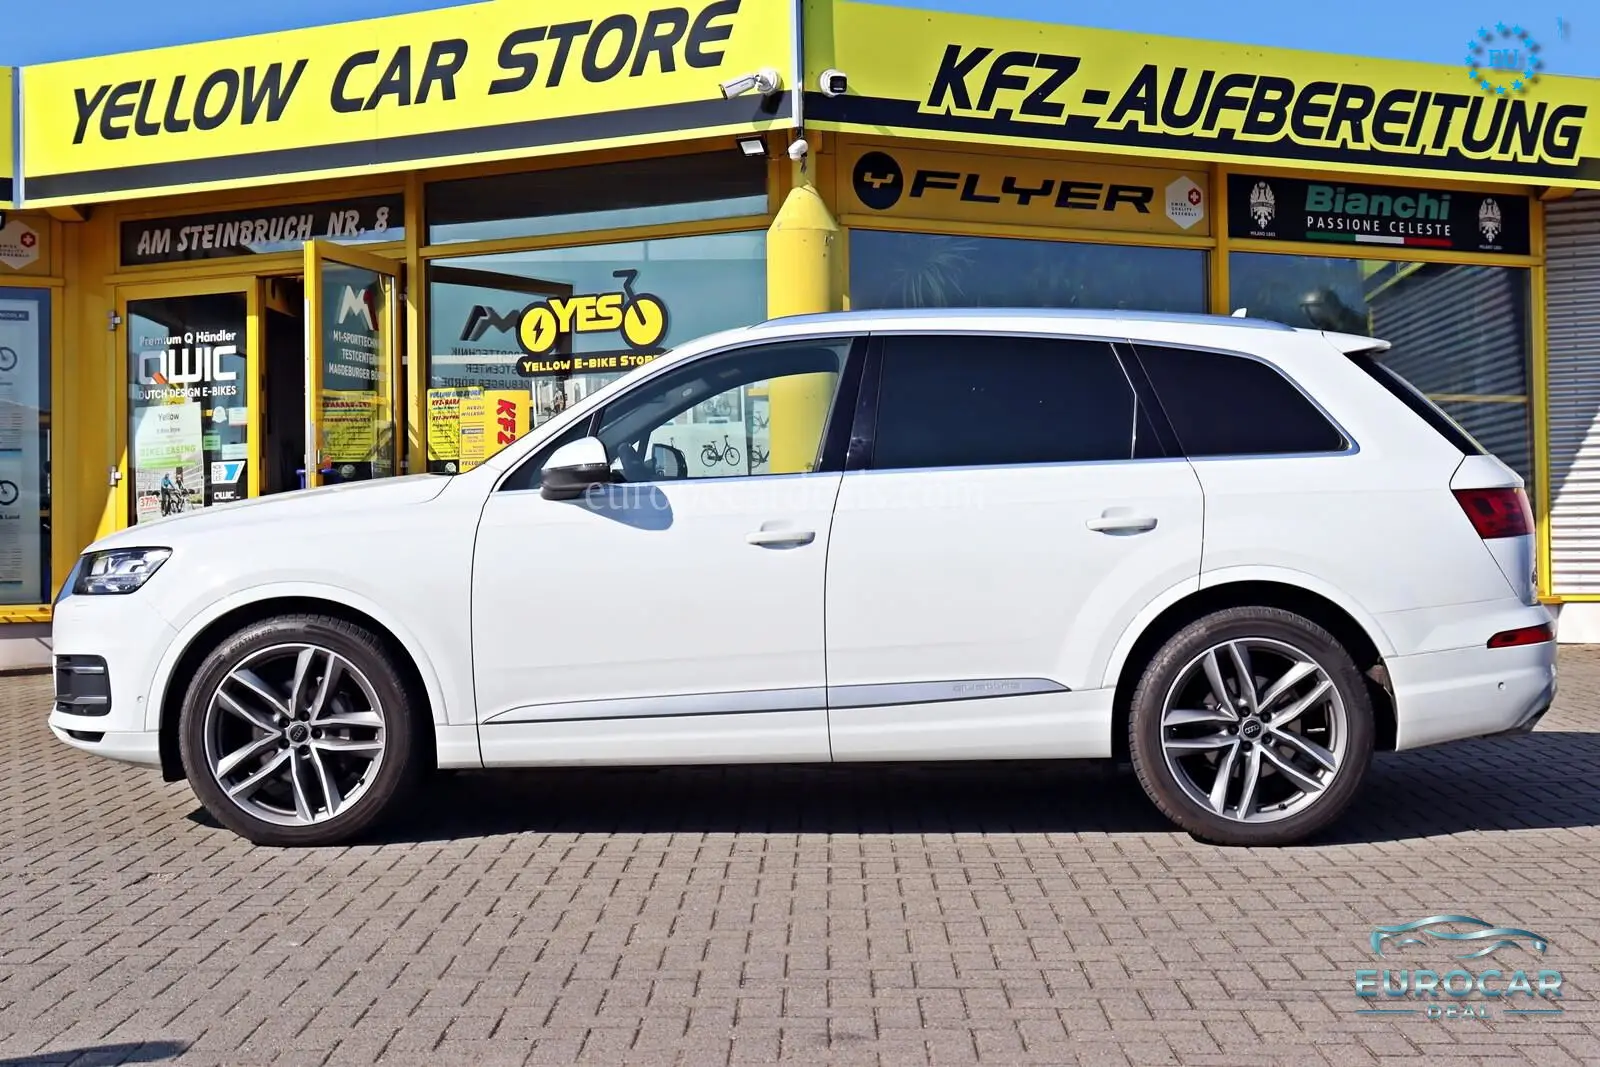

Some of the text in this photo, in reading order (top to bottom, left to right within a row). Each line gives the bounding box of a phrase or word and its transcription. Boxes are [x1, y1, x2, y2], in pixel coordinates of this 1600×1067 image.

[72, 0, 742, 145] YELLOW CAR STORE
[926, 43, 1587, 162] KFZ-AUFBEREITUNG
[909, 169, 1155, 214] FLYER
[1305, 184, 1452, 220] Bianchi
[137, 206, 390, 255] AM STEINBRUCH NR. 8
[1307, 216, 1451, 236] PASSIONE CELESTE
[547, 293, 624, 334] YES
[139, 330, 236, 345] Premium Q Händler
[139, 345, 237, 384] QWIC
[522, 358, 571, 373] YELLOW
[574, 356, 617, 370] E-BIKE
[139, 386, 237, 400] DUTCH DESIGN E-BIKES
[496, 399, 516, 445] KFZ
